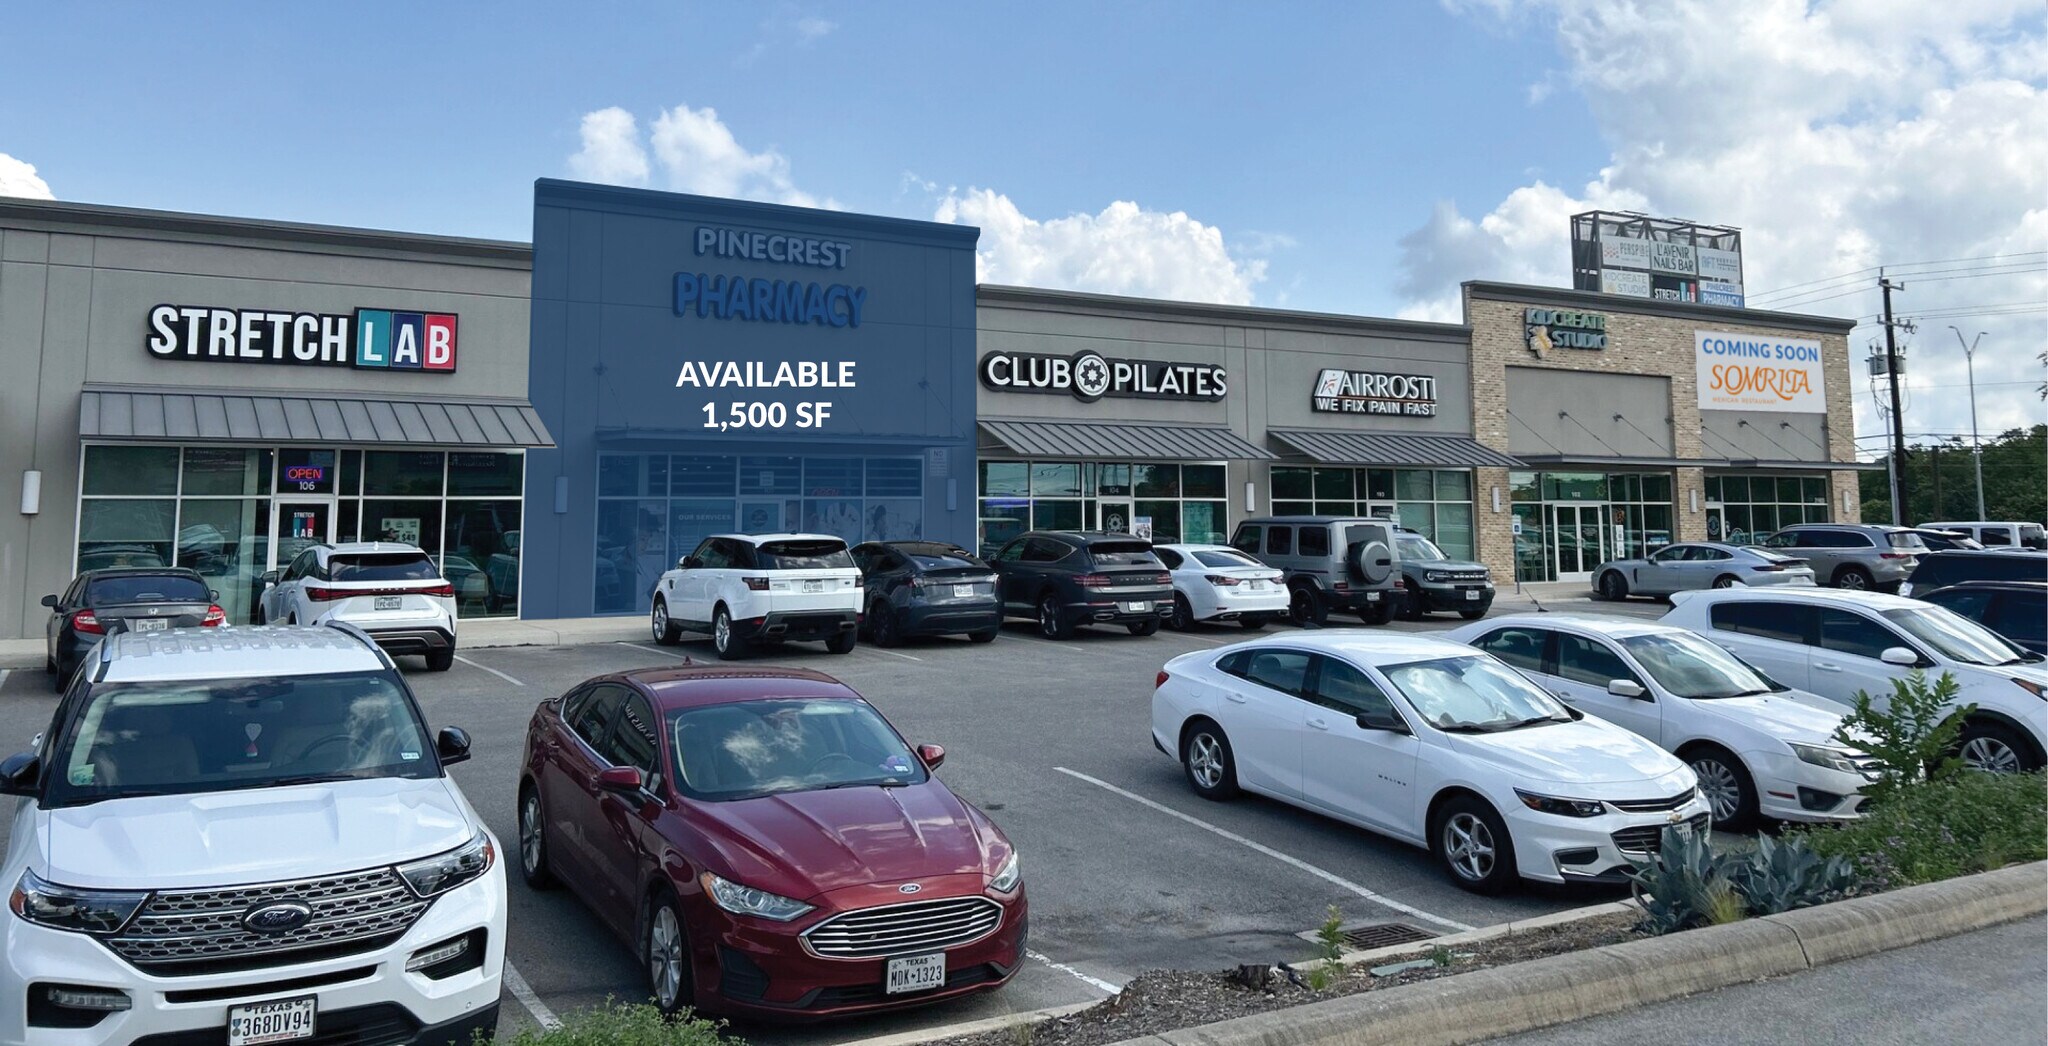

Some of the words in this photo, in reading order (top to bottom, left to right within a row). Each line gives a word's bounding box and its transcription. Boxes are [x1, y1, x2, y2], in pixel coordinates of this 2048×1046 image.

[696, 227, 852, 270] PINECREST
[1656, 243, 1690, 259] L'AVENIR
[1653, 255, 1677, 270] NAILS
[1678, 258, 1694, 272] BAR
[1604, 271, 1648, 284] KIDCREATE
[1617, 283, 1648, 295] STUDIO
[1706, 282, 1736, 293] PINECREST
[673, 272, 868, 329] PHARMACY
[1702, 292, 1741, 307] PHARMACY
[1525, 308, 1606, 331] KIDCREATE
[1551, 330, 1609, 350] STUDIO
[1702, 338, 1771, 359] COMING
[1775, 345, 1819, 363] SOON
[987, 355, 1072, 389] CLUB
[1114, 362, 1228, 397] PILATES
[1709, 364, 1813, 401] SOMRITA
[1339, 371, 1438, 400] AIRROSTI
[1316, 398, 1339, 411] WE
[1343, 399, 1366, 412] FIX
[1370, 401, 1401, 414] PAIN
[1404, 402, 1438, 415] FAST
[288, 468, 322, 479] OPEN
[299, 481, 315, 491] 106
[293, 528, 314, 538] LAB
[905, 957, 929, 966] TEXAS
[253, 1002, 293, 1015] TEXAS
[242, 1010, 312, 1037] 368DV94
